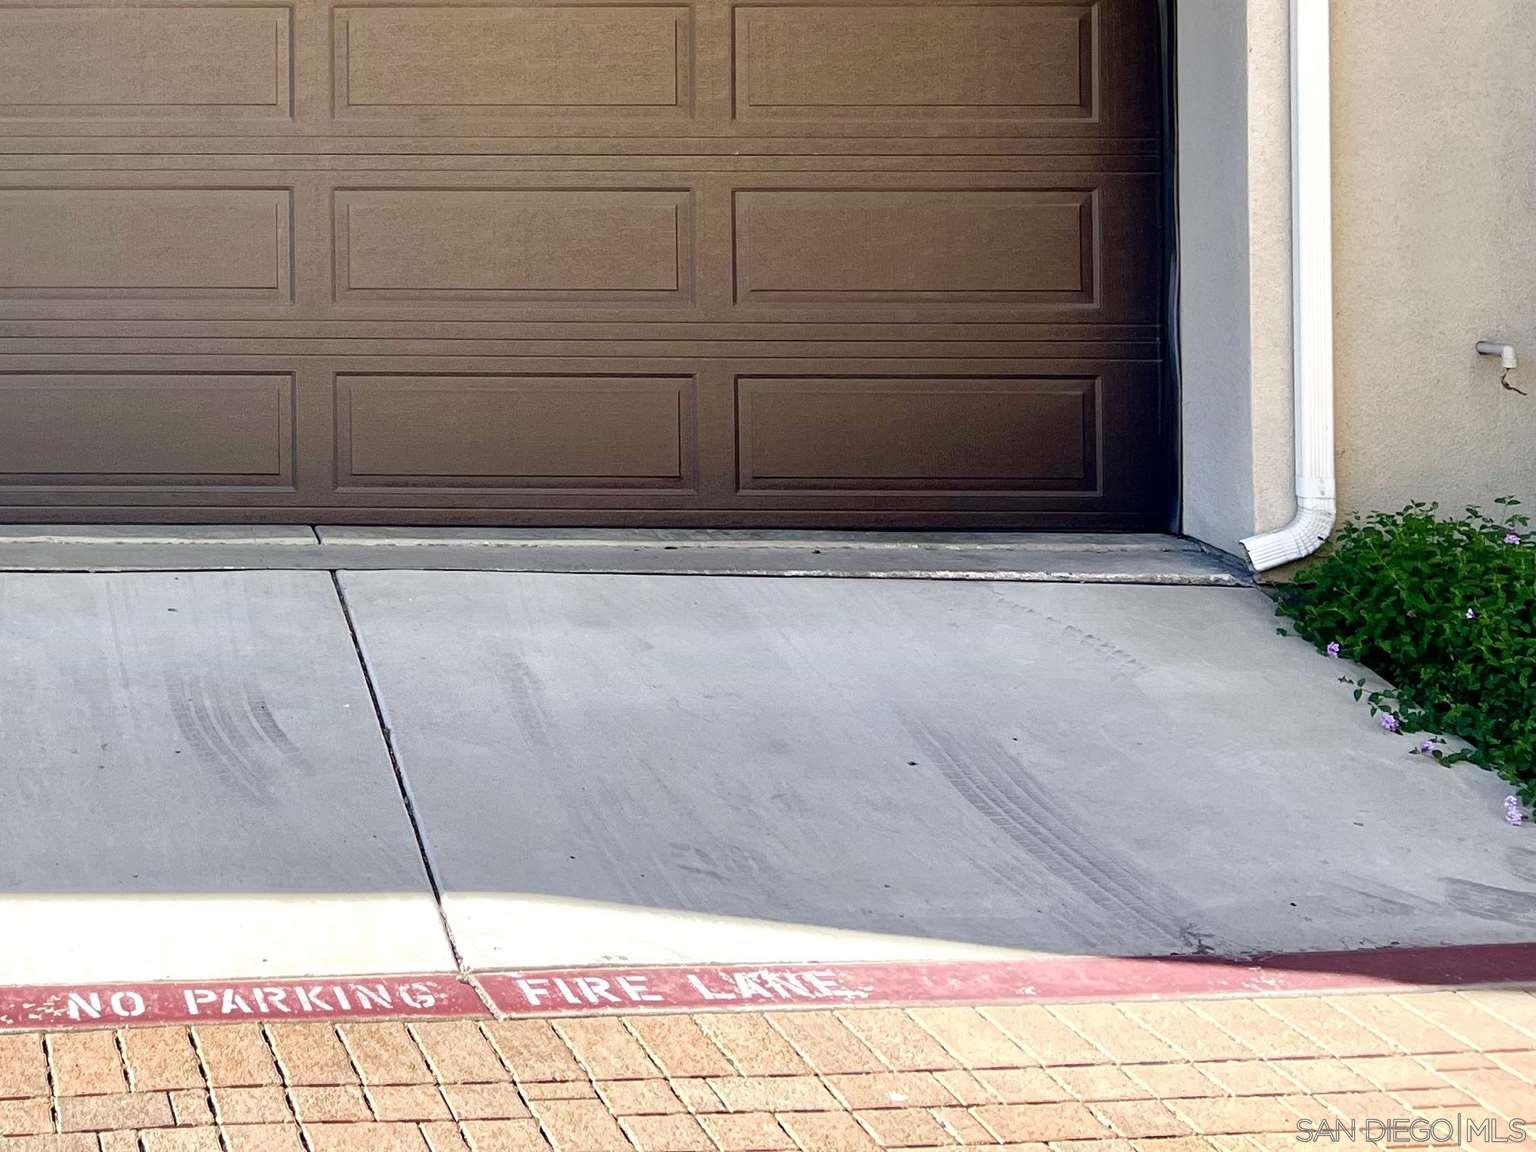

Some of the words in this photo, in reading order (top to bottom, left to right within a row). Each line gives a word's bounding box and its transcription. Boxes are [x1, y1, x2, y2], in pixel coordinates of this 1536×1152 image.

[67, 991, 146, 1020] NO
[183, 982, 438, 1015] PARKING
[516, 975, 665, 1006] FIRE
[686, 970, 848, 1000] LANE
